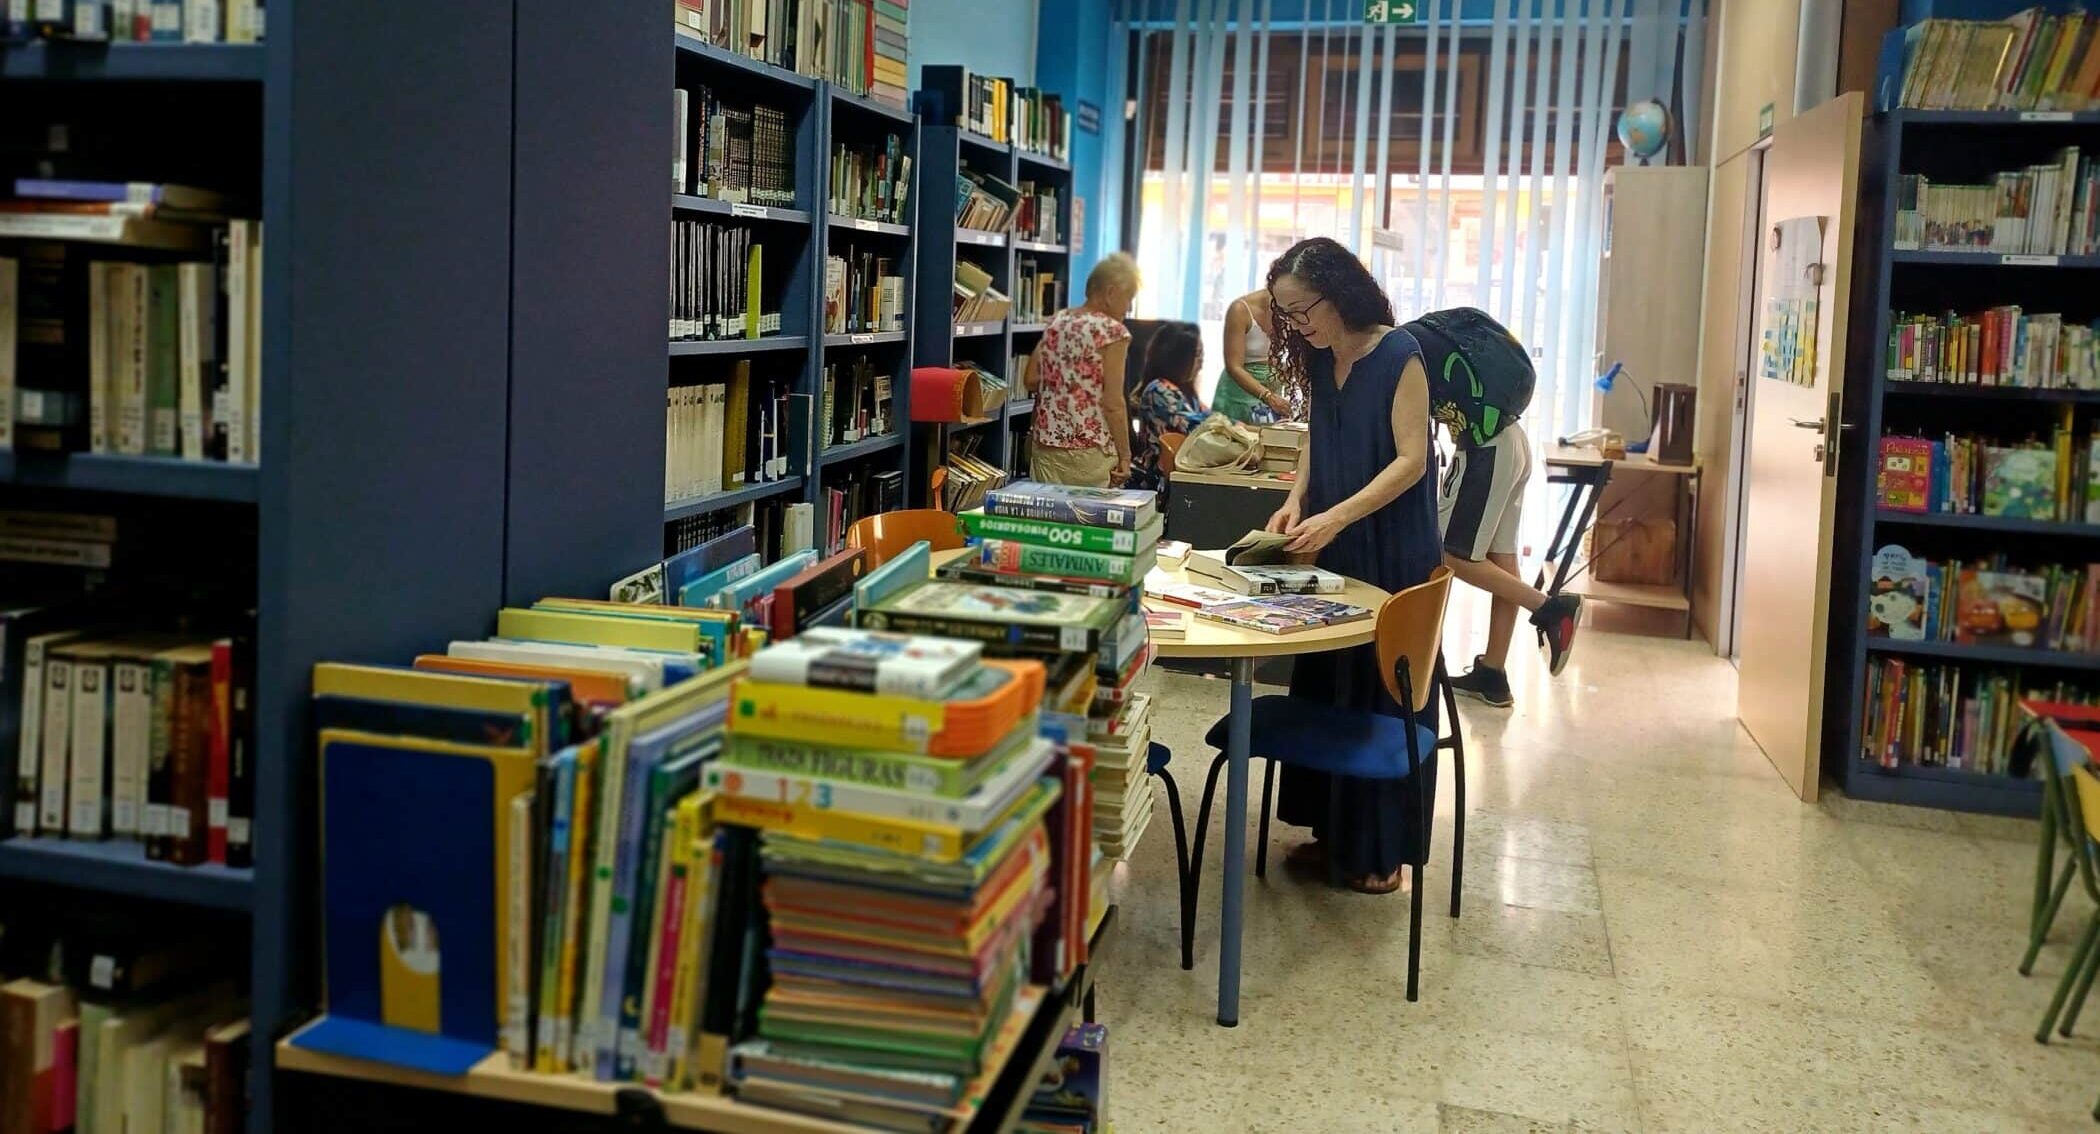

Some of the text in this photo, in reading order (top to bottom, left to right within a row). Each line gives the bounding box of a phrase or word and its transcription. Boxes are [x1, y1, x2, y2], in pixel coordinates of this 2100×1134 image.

[979, 519, 1084, 545] 500 DINOSAURIOS
[1029, 551, 1107, 575] ANIMALES
